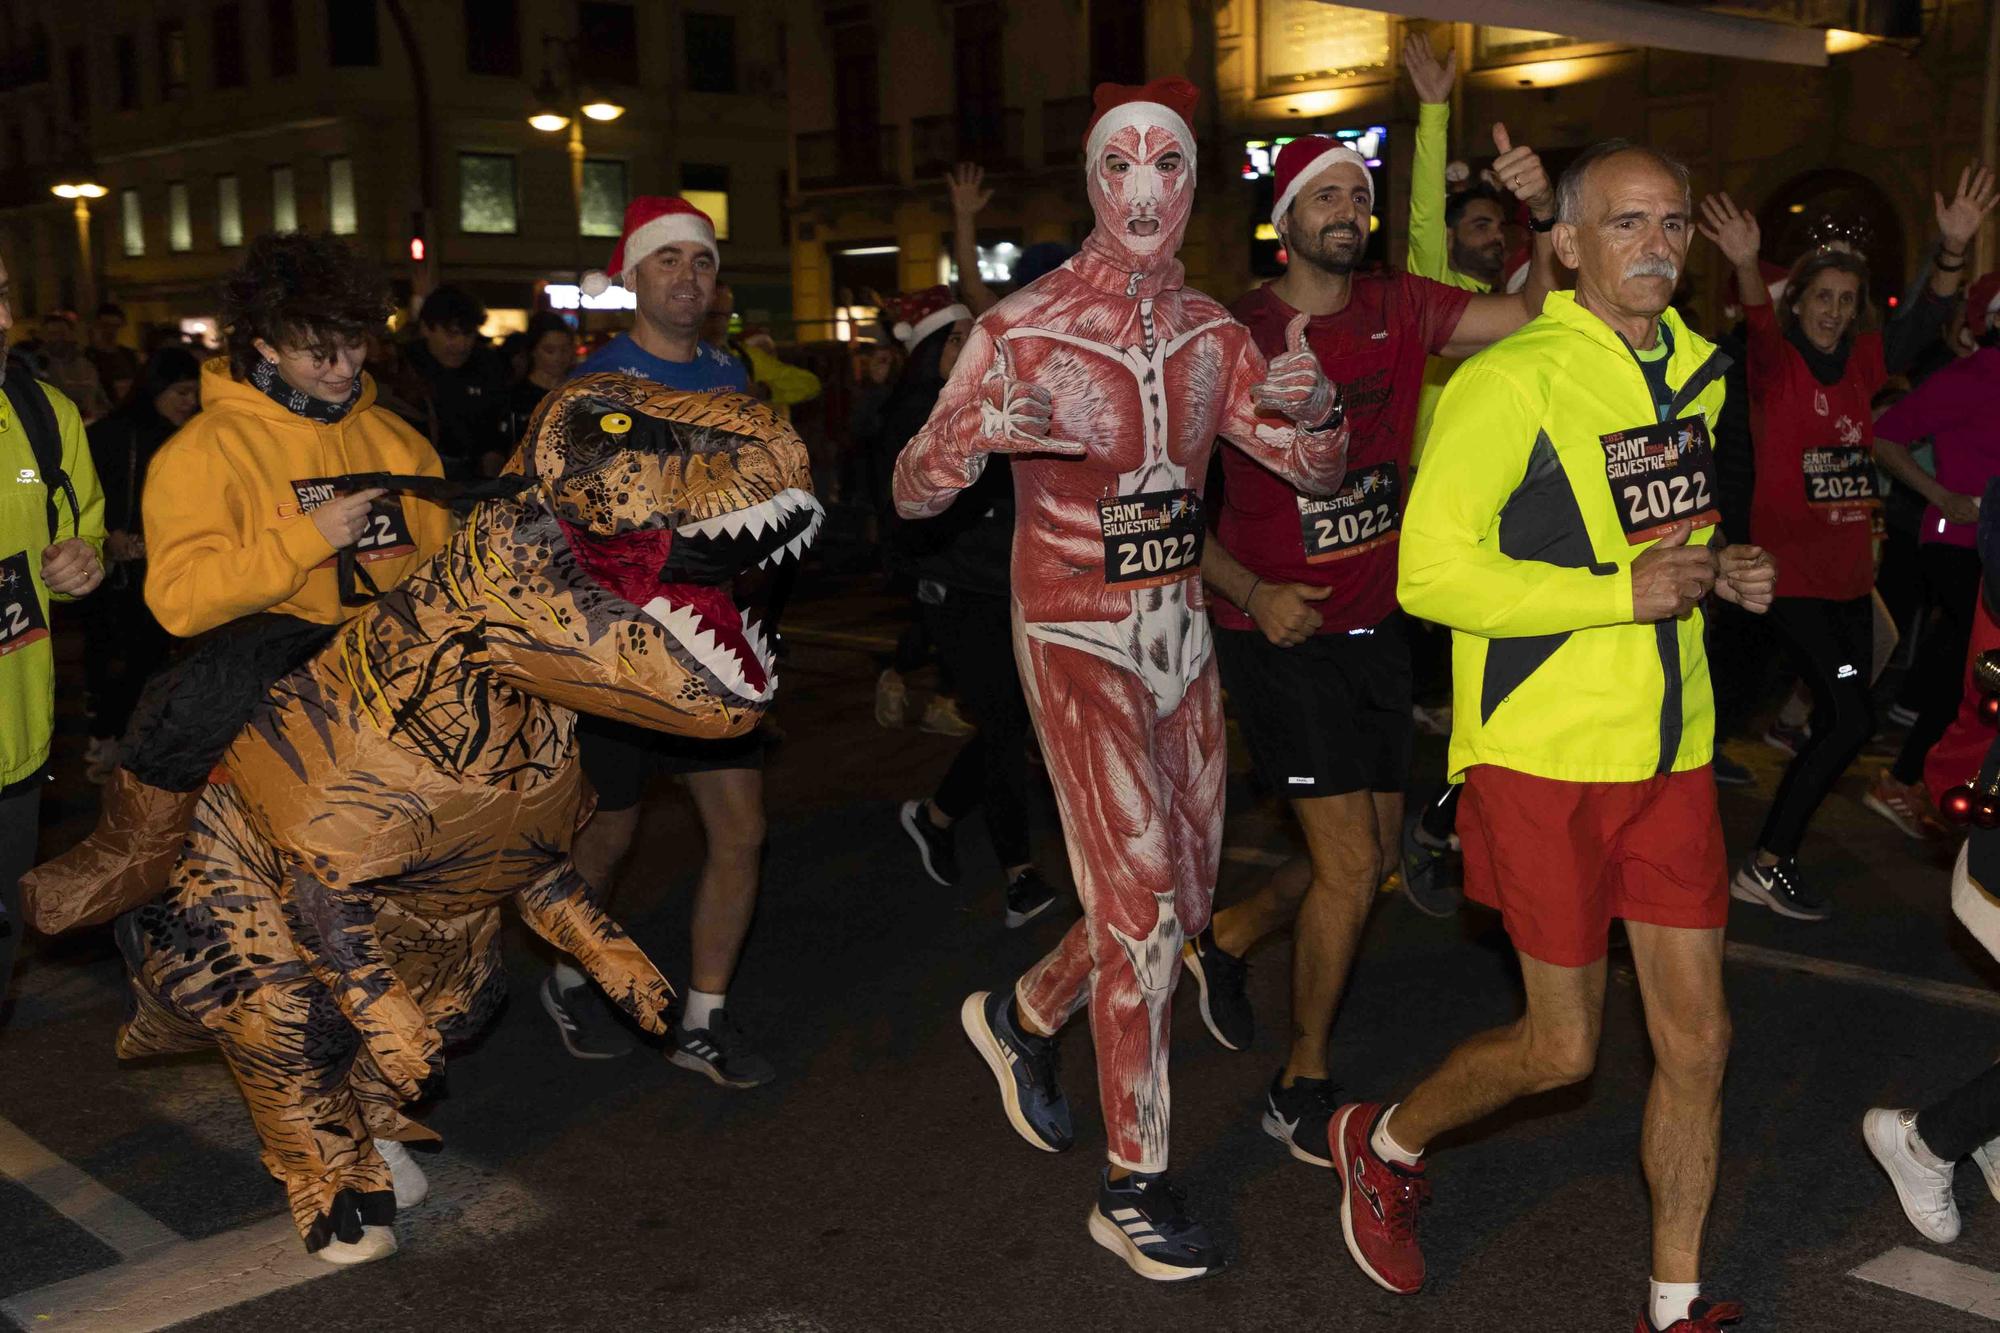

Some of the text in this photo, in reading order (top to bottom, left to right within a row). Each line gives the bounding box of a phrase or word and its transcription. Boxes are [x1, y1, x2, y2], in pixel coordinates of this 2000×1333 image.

[1606, 436, 1649, 463] SANT
[297, 484, 336, 503] SANT
[1623, 471, 1711, 525] 2022
[1812, 476, 1873, 499] 2022
[1101, 502, 1145, 524] SANT
[1314, 503, 1392, 549] 2022
[1117, 533, 1196, 576] 2022
[0, 602, 30, 641] 2
